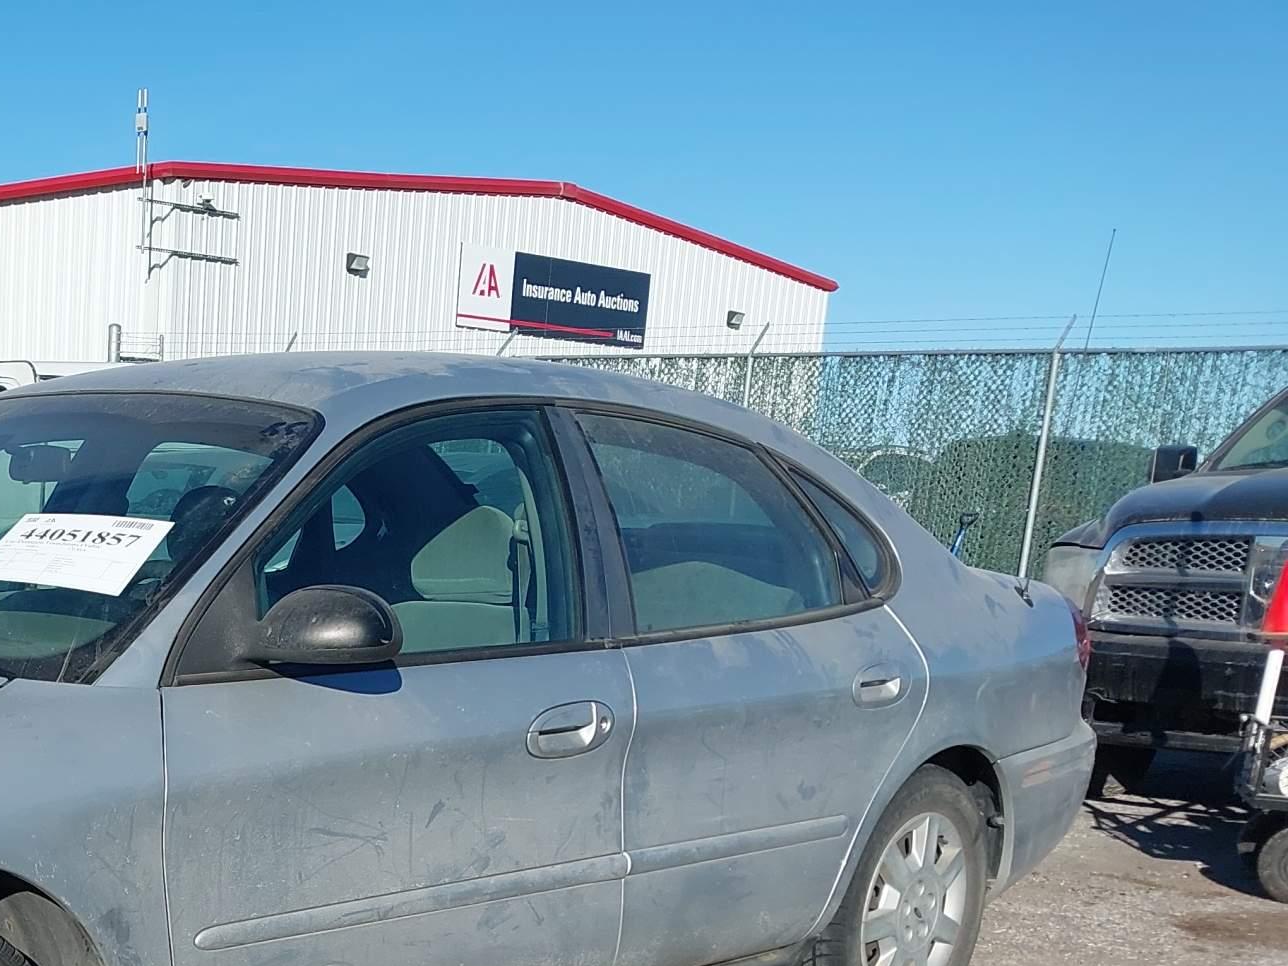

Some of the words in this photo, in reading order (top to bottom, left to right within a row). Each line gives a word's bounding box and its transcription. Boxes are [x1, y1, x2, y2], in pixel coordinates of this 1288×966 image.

[522, 278, 572, 303] Insurance
[573, 287, 597, 307] Auto
[597, 290, 640, 313] Auctions
[616, 329, 643, 343] IAAI.com
[20, 527, 141, 548] 44051857
